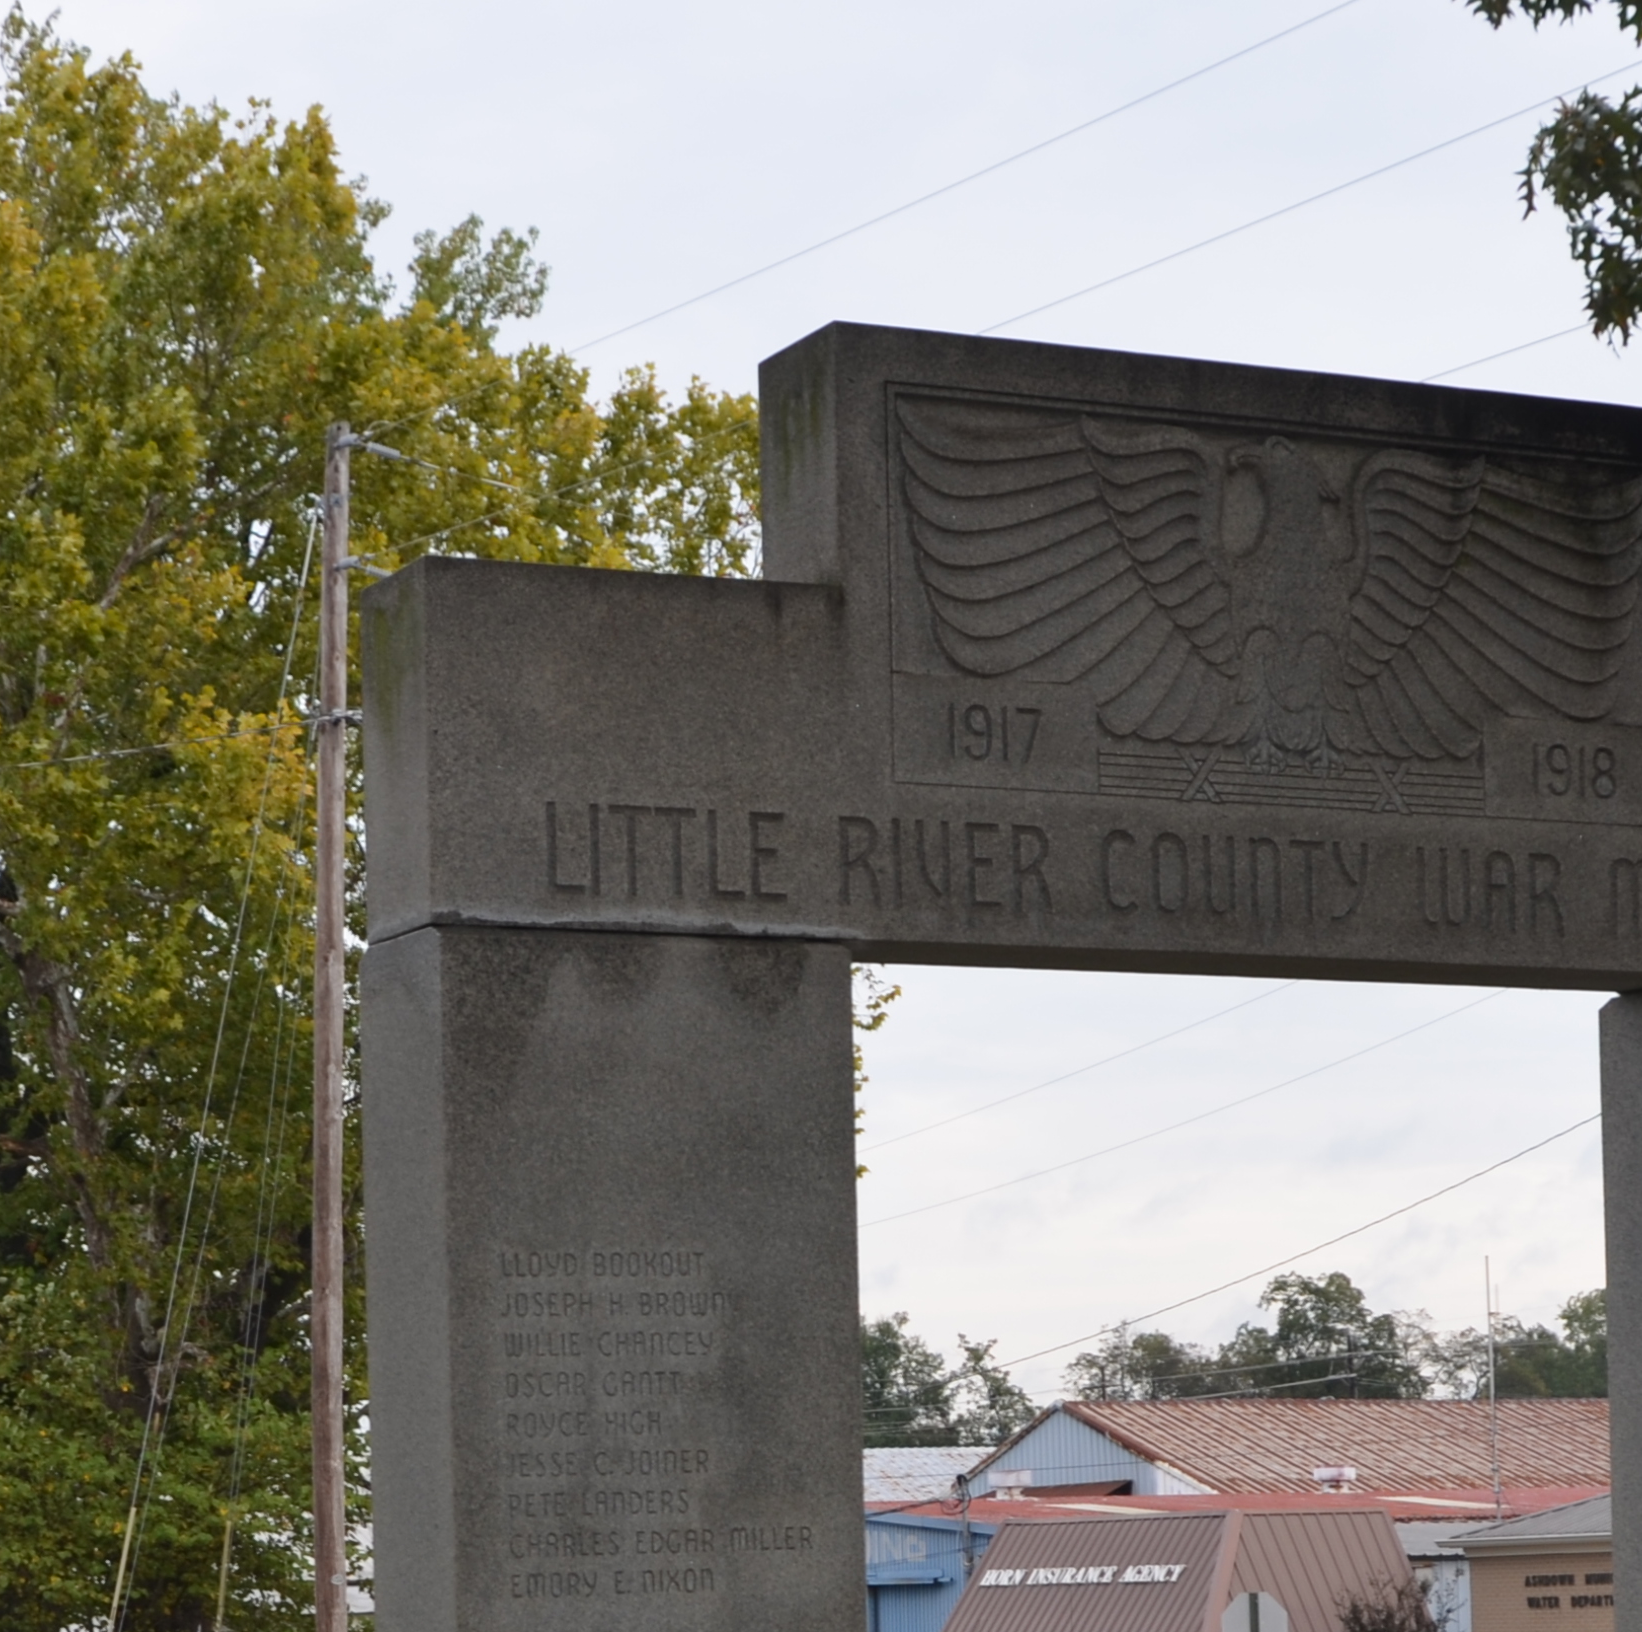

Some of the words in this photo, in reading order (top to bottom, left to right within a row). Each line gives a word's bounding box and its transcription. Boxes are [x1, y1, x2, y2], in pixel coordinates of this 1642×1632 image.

[946, 700, 1044, 766] 1917
[1532, 742, 1619, 800] 1918
[545, 800, 789, 905] LITTLE
[837, 813, 1055, 915] RIVER
[1099, 827, 1371, 933] COUNTY
[1414, 845, 1567, 939] WAR
[500, 1251, 578, 1279] LLOYD
[593, 1250, 705, 1278] BOOKOUT
[500, 1291, 593, 1319] JOSEPH
[609, 1292, 629, 1317] H.
[639, 1290, 726, 1318] BROWN
[504, 1331, 582, 1359] WILLIE
[596, 1330, 714, 1357] CHANCEY
[506, 1371, 587, 1398] OSCAR
[602, 1370, 681, 1397] GANTT
[506, 1410, 588, 1438] ROYCE
[604, 1409, 662, 1435] HIGH
[507, 1451, 578, 1479] JESSE
[593, 1450, 615, 1476] C.
[624, 1448, 710, 1476] JOINER
[508, 1491, 567, 1518] PETE
[581, 1488, 690, 1516] LANDERS
[509, 1528, 621, 1560] CHARLES
[635, 1528, 716, 1556] EDGAR
[729, 1525, 815, 1553] MILLER
[511, 1571, 598, 1599] EMORY
[641, 1567, 716, 1595] NIXON
[979, 1568, 1027, 1587] HORN
[1026, 1565, 1118, 1586] INSURANCE
[1119, 1563, 1187, 1584] AGENCY
[1525, 1574, 1575, 1587] ASHDOWN
[1527, 1595, 1560, 1609] WATER
